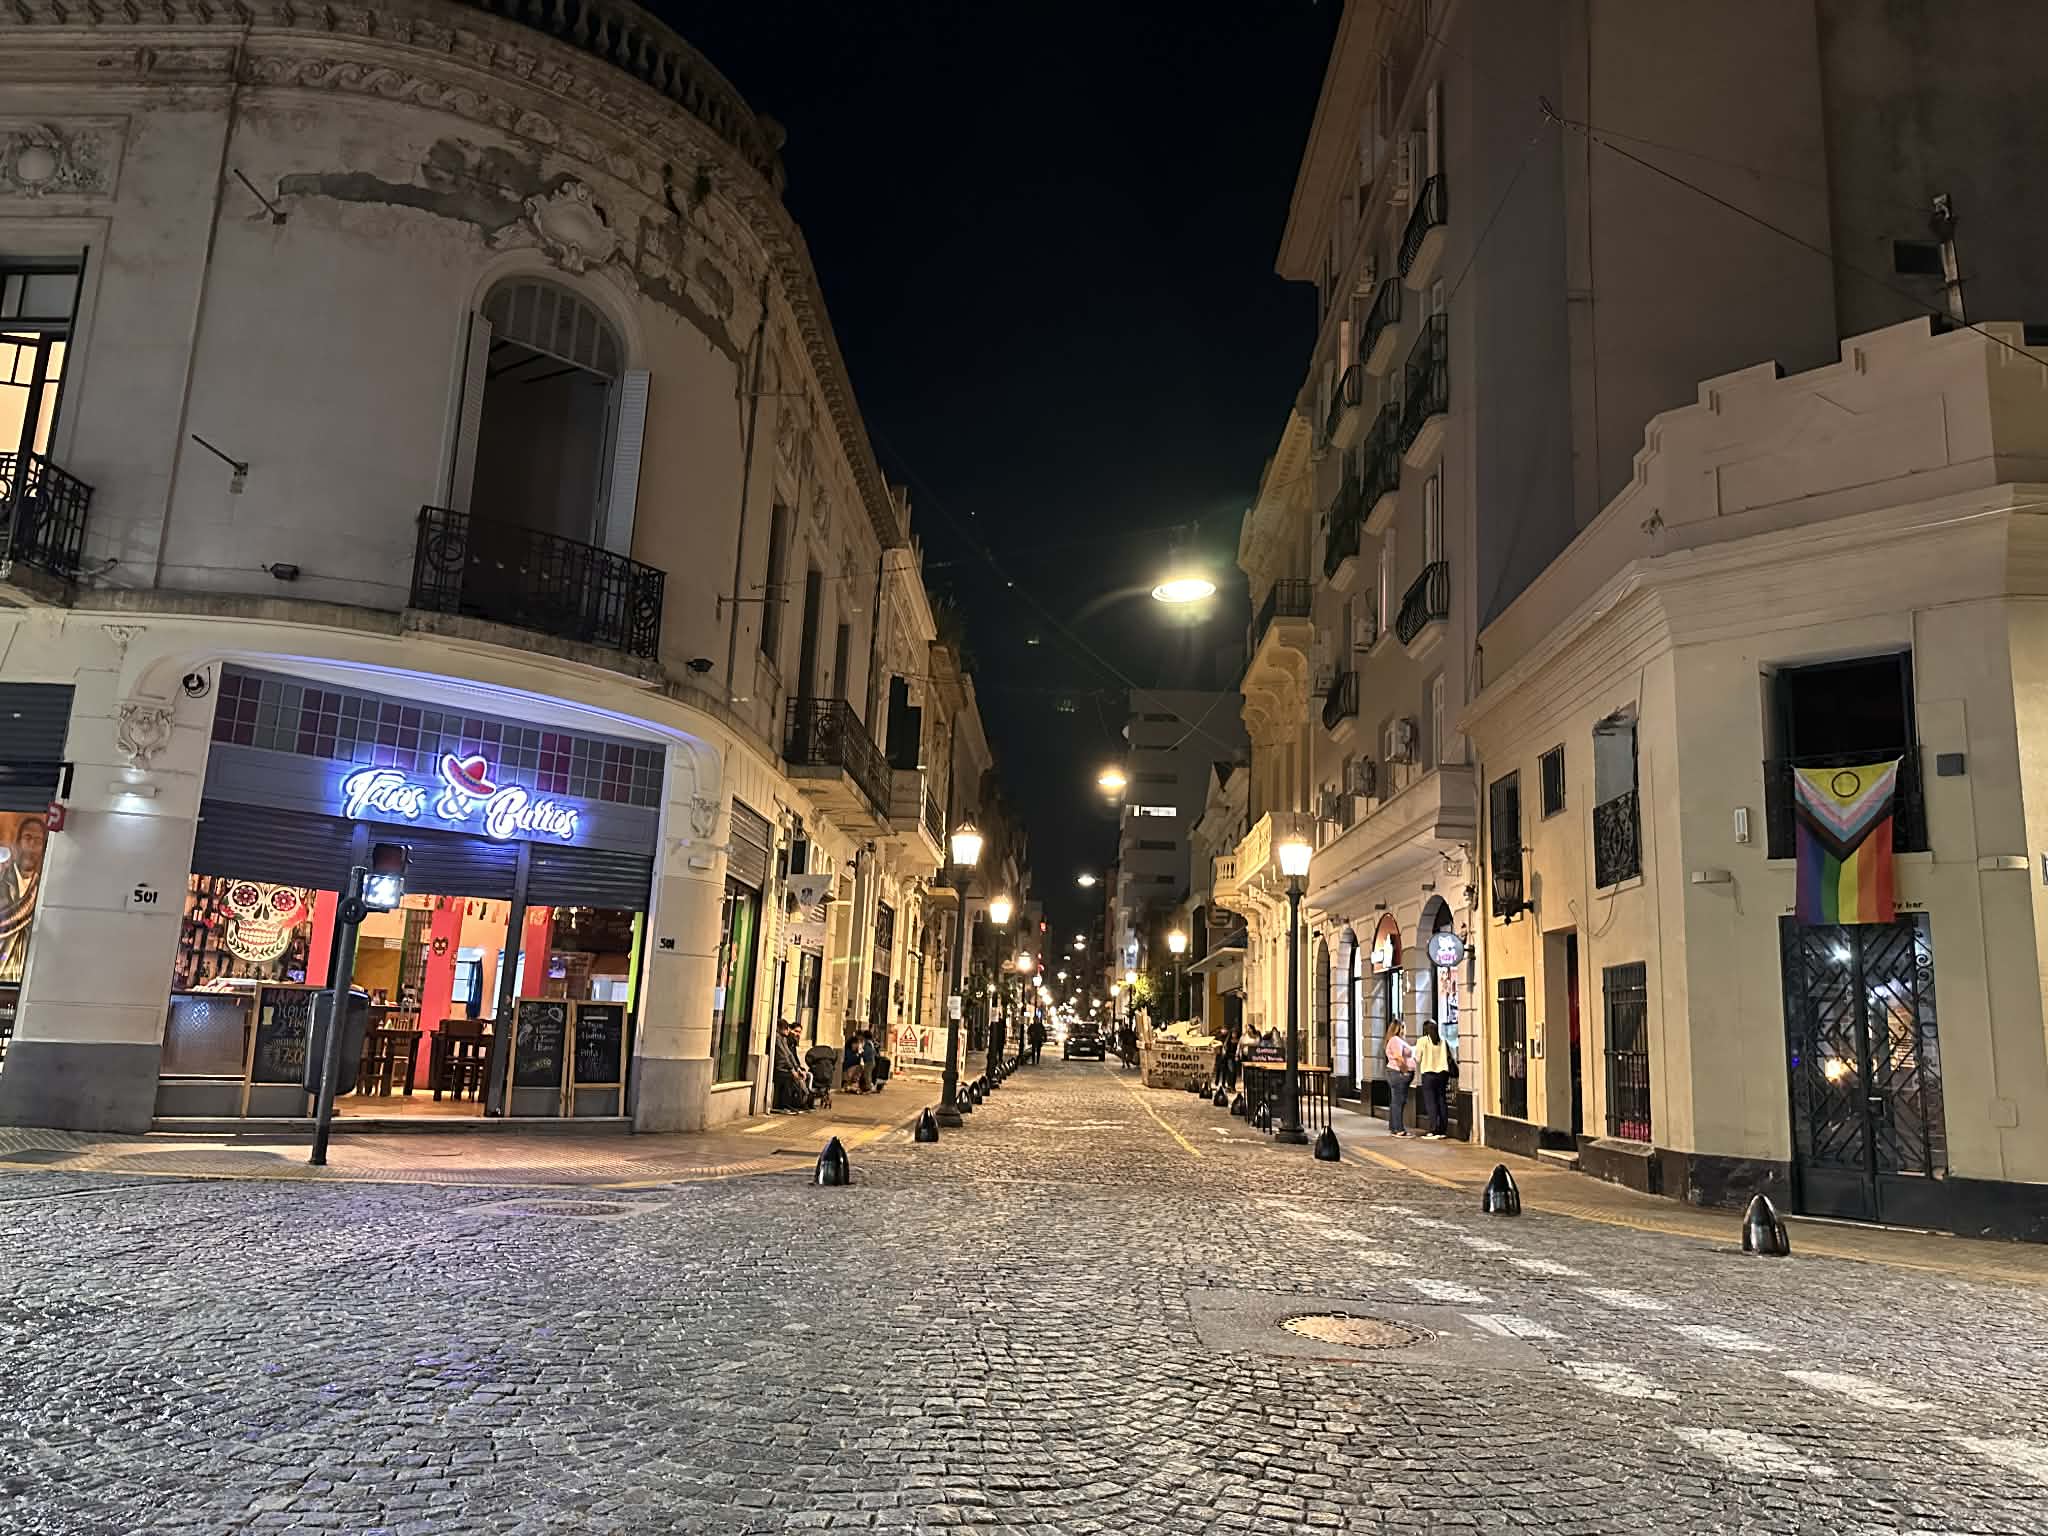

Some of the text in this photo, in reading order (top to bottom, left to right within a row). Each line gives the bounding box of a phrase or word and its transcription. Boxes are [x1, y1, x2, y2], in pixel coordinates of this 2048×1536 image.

[344, 769, 578, 840] Tacos & Burros
[134, 889, 158, 904] 501
